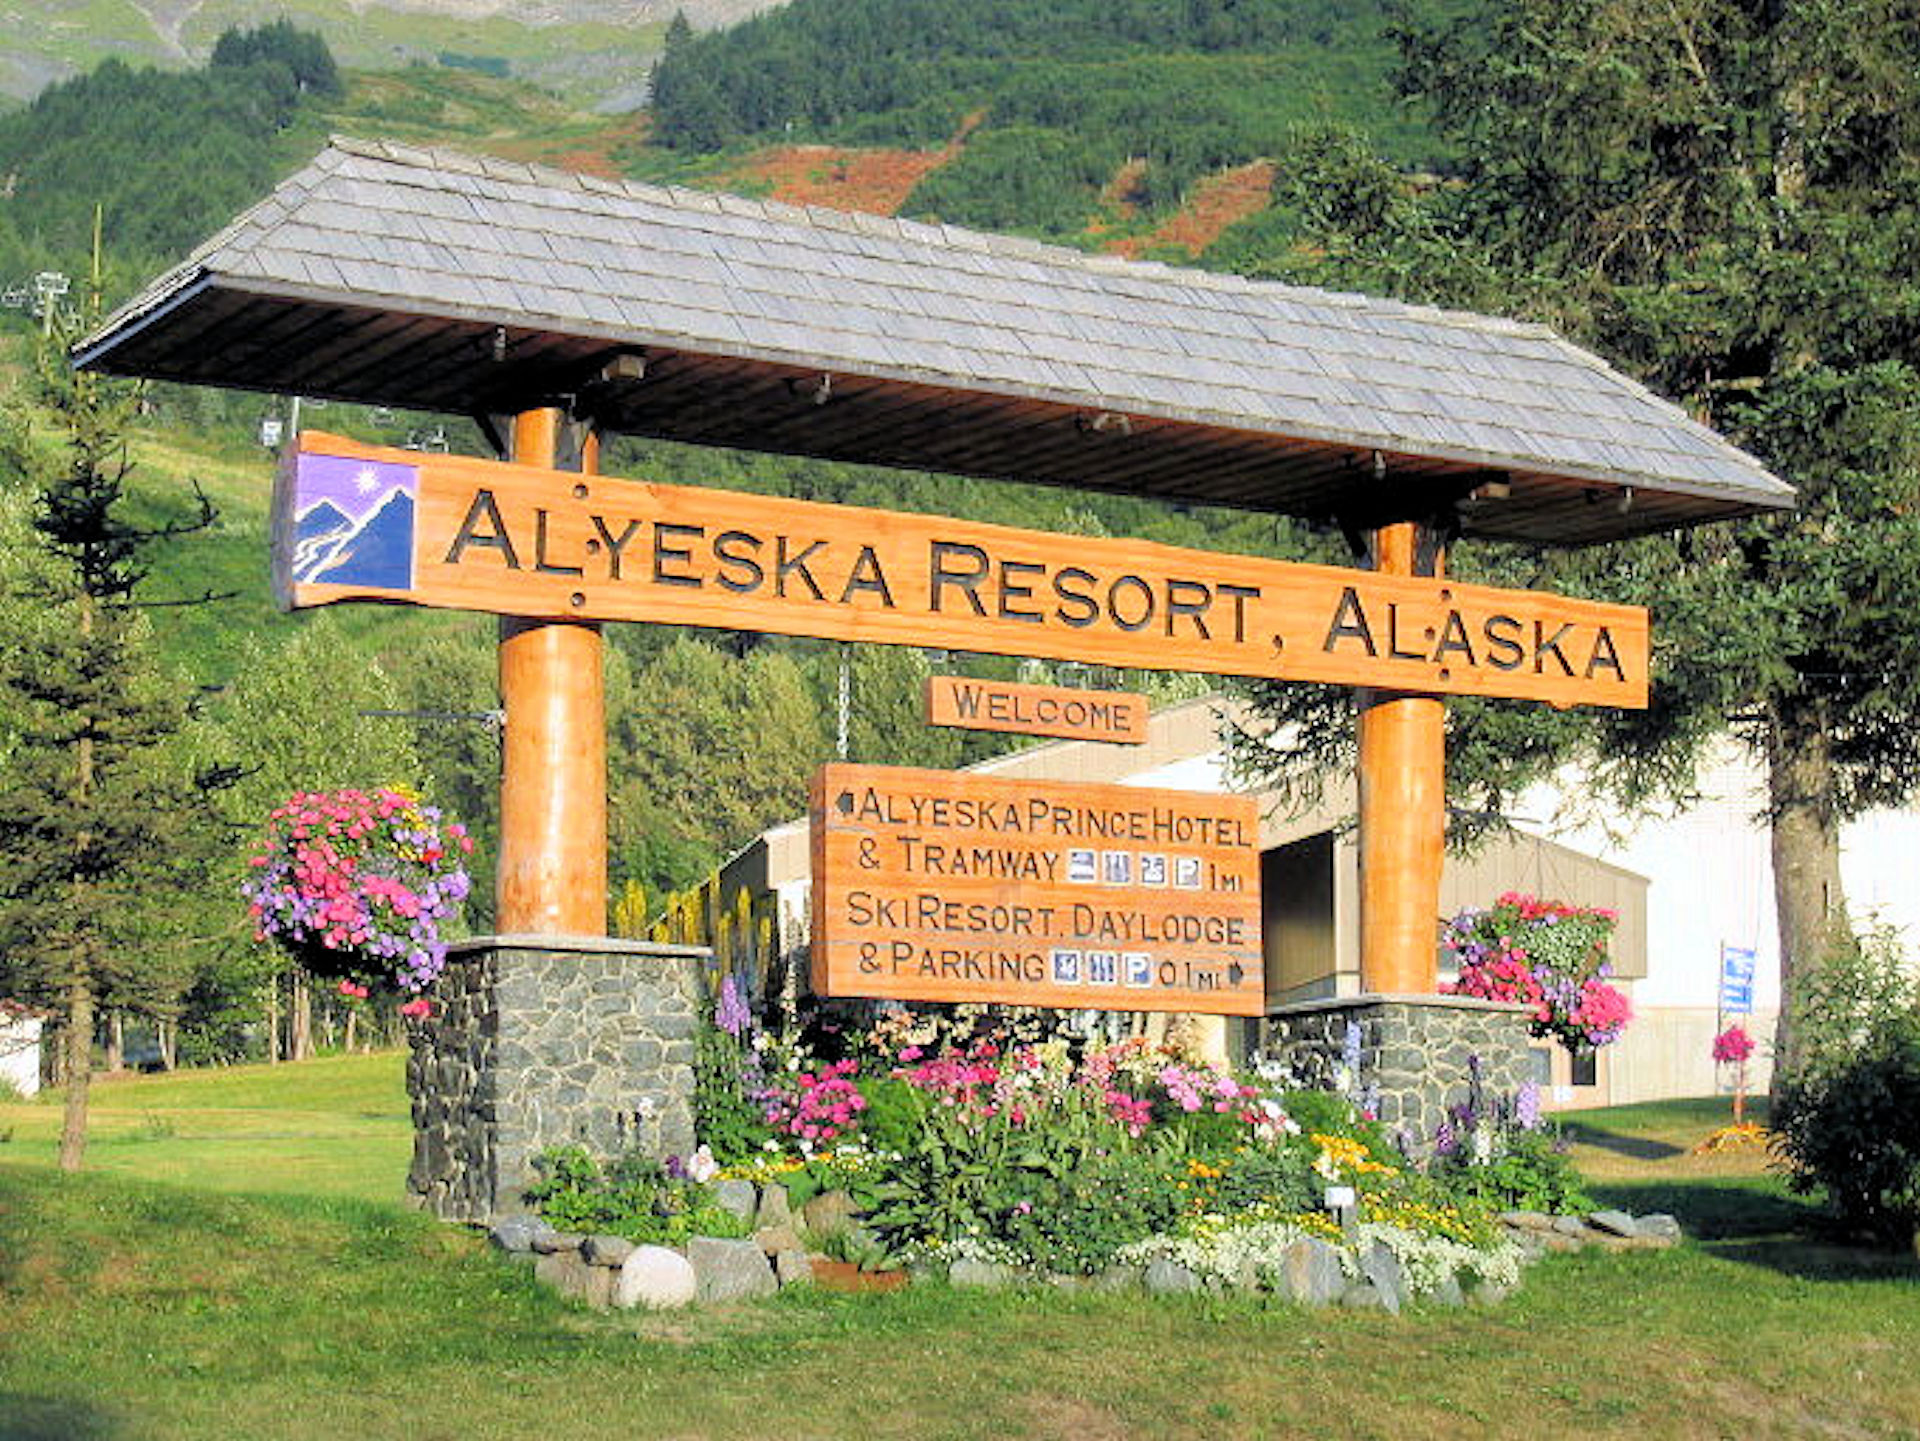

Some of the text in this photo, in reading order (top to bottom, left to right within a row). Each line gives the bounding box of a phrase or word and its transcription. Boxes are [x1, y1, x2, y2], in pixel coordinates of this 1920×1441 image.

[444, 488, 896, 609] ALYESKA
[1322, 586, 1628, 683] ALASKA
[952, 683, 1132, 732] WELCOME
[857, 787, 1252, 847] ALYESKA PRINCE HOTEL
[859, 837, 880, 869] &
[897, 834, 1060, 884] TRAMWAY
[846, 891, 909, 928] SKI
[859, 942, 881, 974] &
[892, 940, 1045, 982] PARKING
